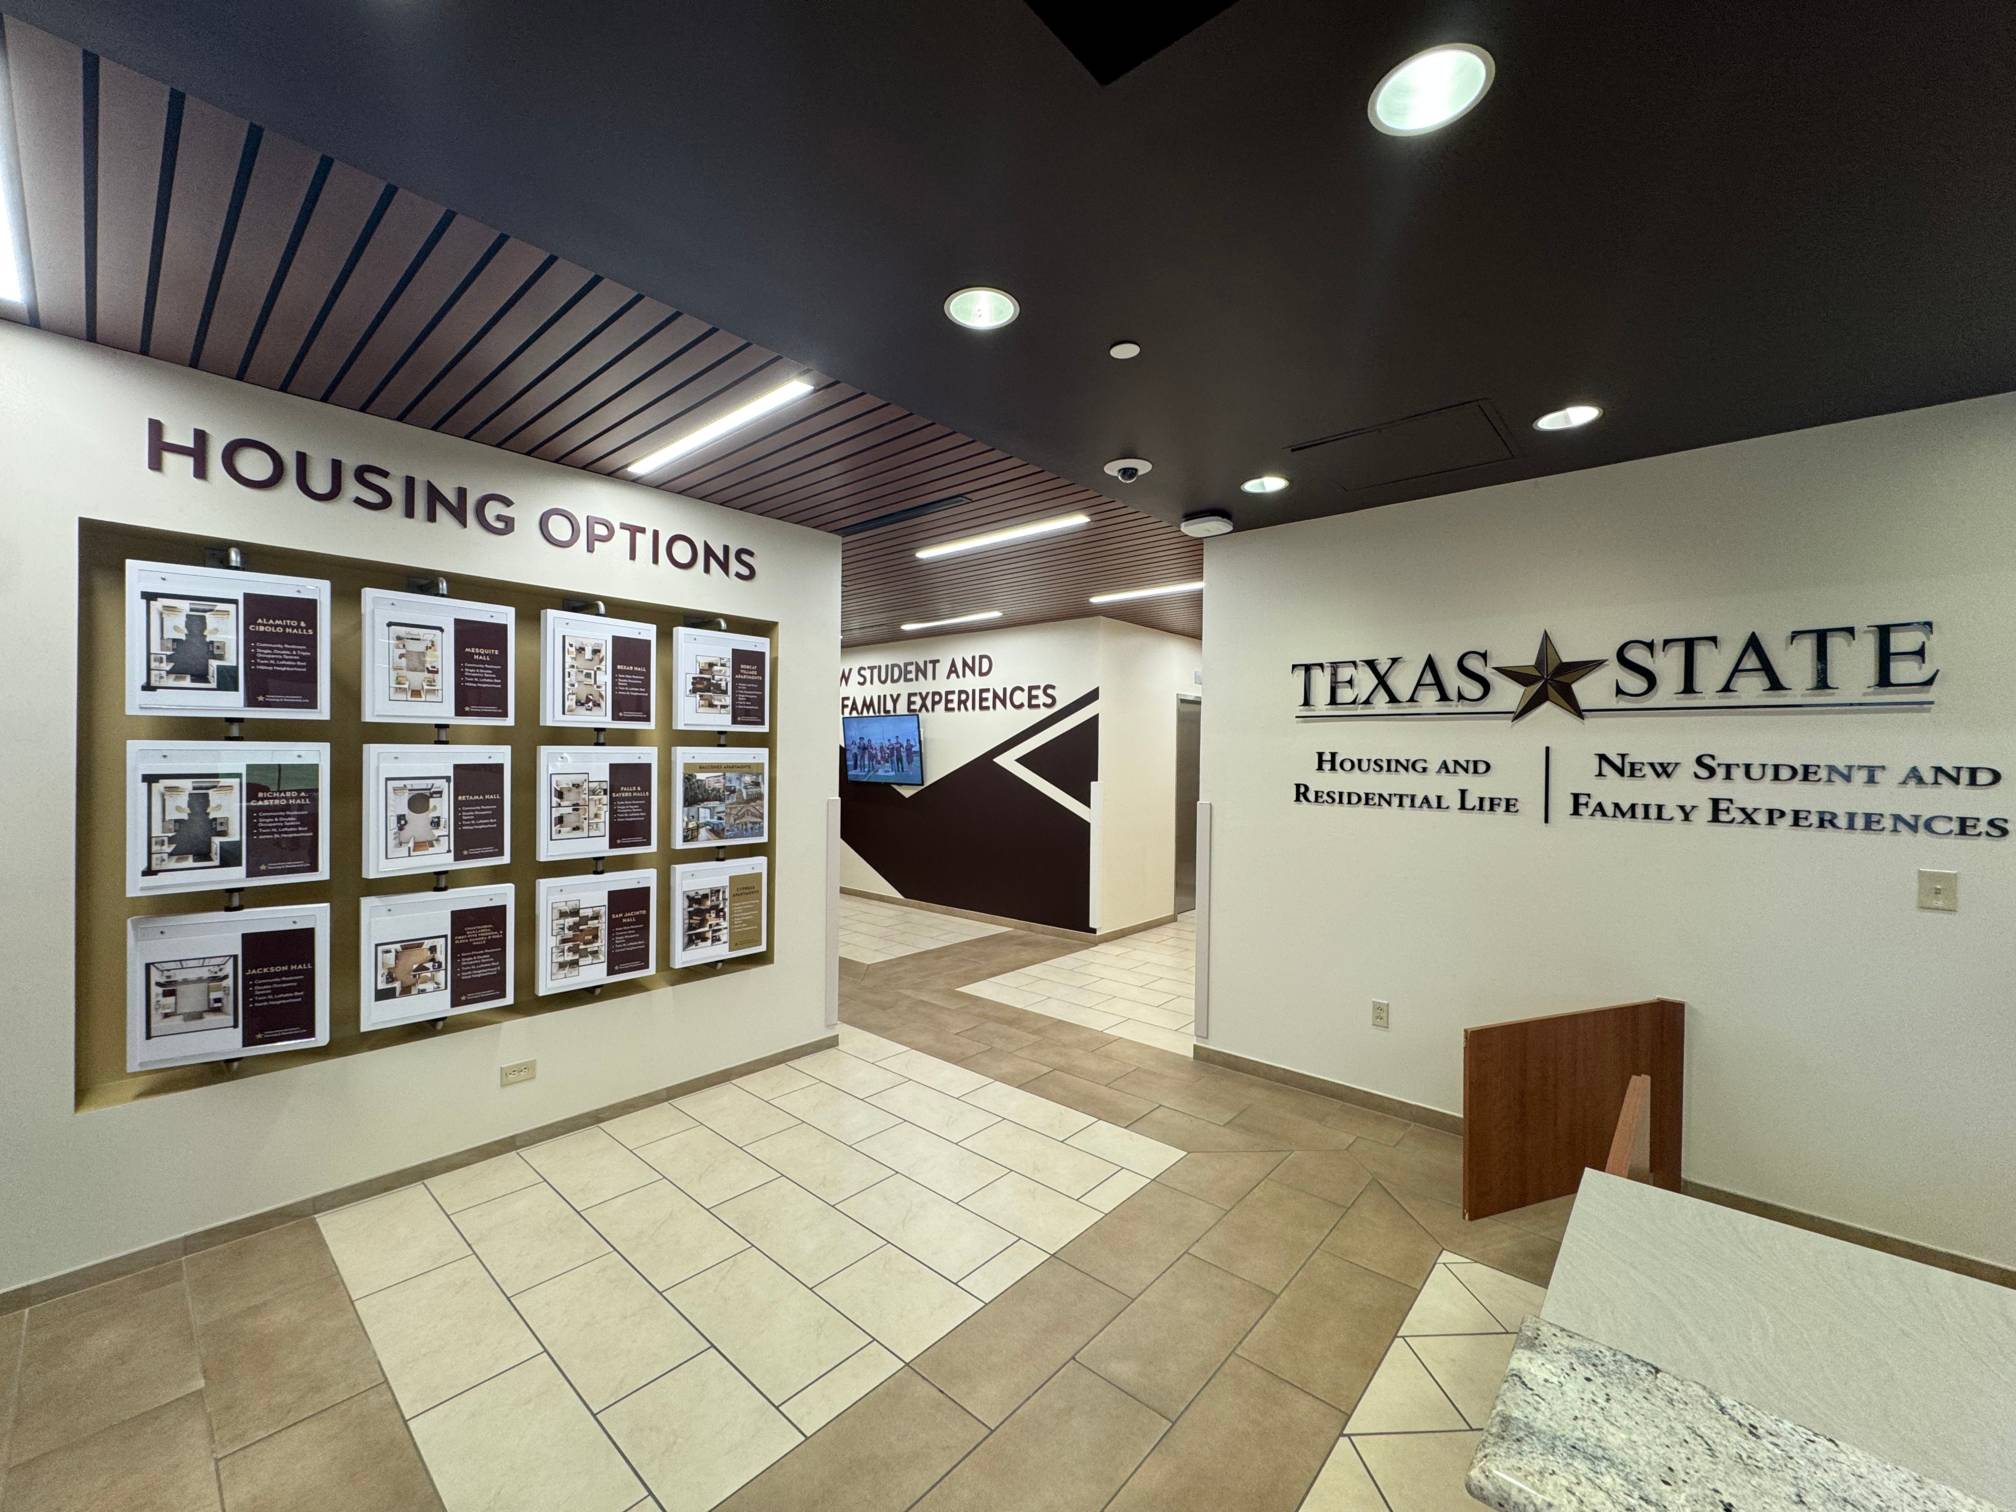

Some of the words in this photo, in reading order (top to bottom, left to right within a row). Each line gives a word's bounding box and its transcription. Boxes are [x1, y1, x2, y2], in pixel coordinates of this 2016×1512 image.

[148, 418, 515, 536] HOUSING
[539, 507, 757, 581] OPTIONS
[249, 625, 283, 633] CIBOLO
[286, 627, 313, 635] HALLS
[256, 618, 297, 626] ALAMITO
[464, 647, 499, 655] MESQUITE
[1291, 650, 1491, 707] TEXAS
[1615, 620, 1940, 698] STATE
[857, 659, 940, 686] STUDENT
[946, 654, 993, 679] AND
[841, 693, 901, 715] FAMILY
[906, 684, 1057, 713] EXPERIENCES
[1316, 751, 1428, 774] HOUSING
[1436, 758, 1491, 775] AND
[1594, 753, 1680, 779] NEW
[1694, 753, 1886, 785] STUDENT
[1903, 765, 2002, 787] AND
[1294, 783, 1449, 810] RESIDENTIAL
[1457, 789, 1519, 814] LIFE
[1569, 792, 1698, 823] FAMILY
[1707, 797, 2010, 838] EXPERIENCES
[624, 909, 647, 918] JACINTO
[245, 965, 288, 975] JACKSON
